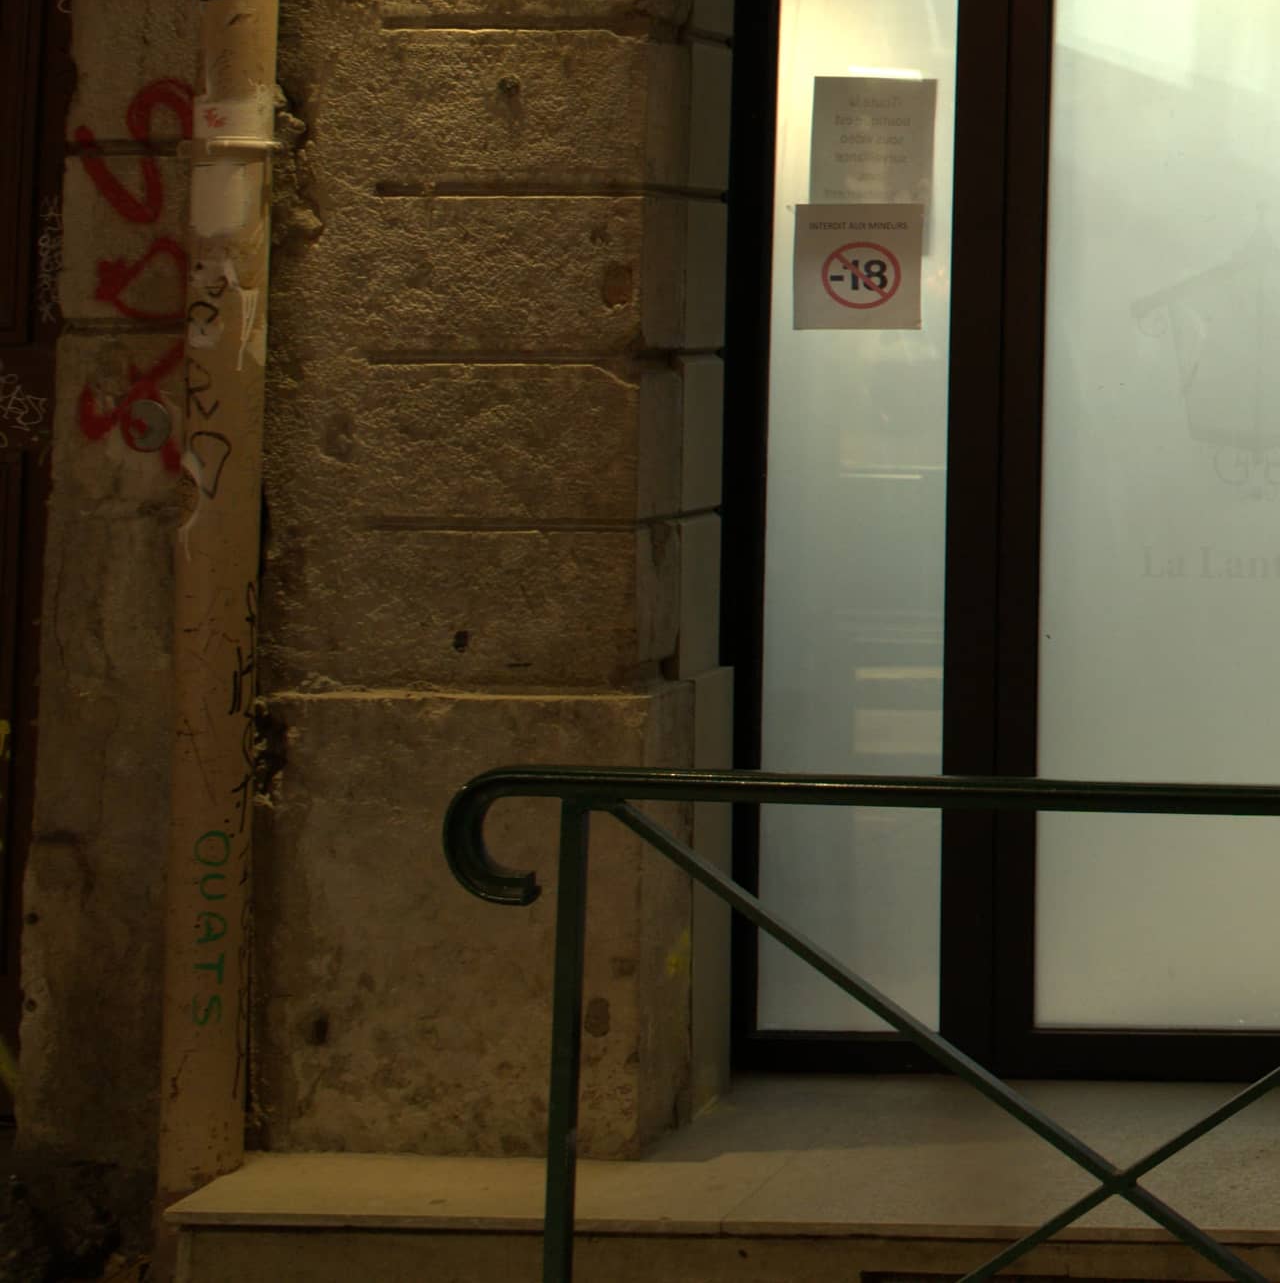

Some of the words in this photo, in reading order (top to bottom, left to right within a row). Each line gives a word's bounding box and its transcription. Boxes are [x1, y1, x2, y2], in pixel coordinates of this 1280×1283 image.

[808, 221, 847, 231] INTERDIT
[829, 258, 889, 291] -18
[1140, 545, 1185, 580] La
